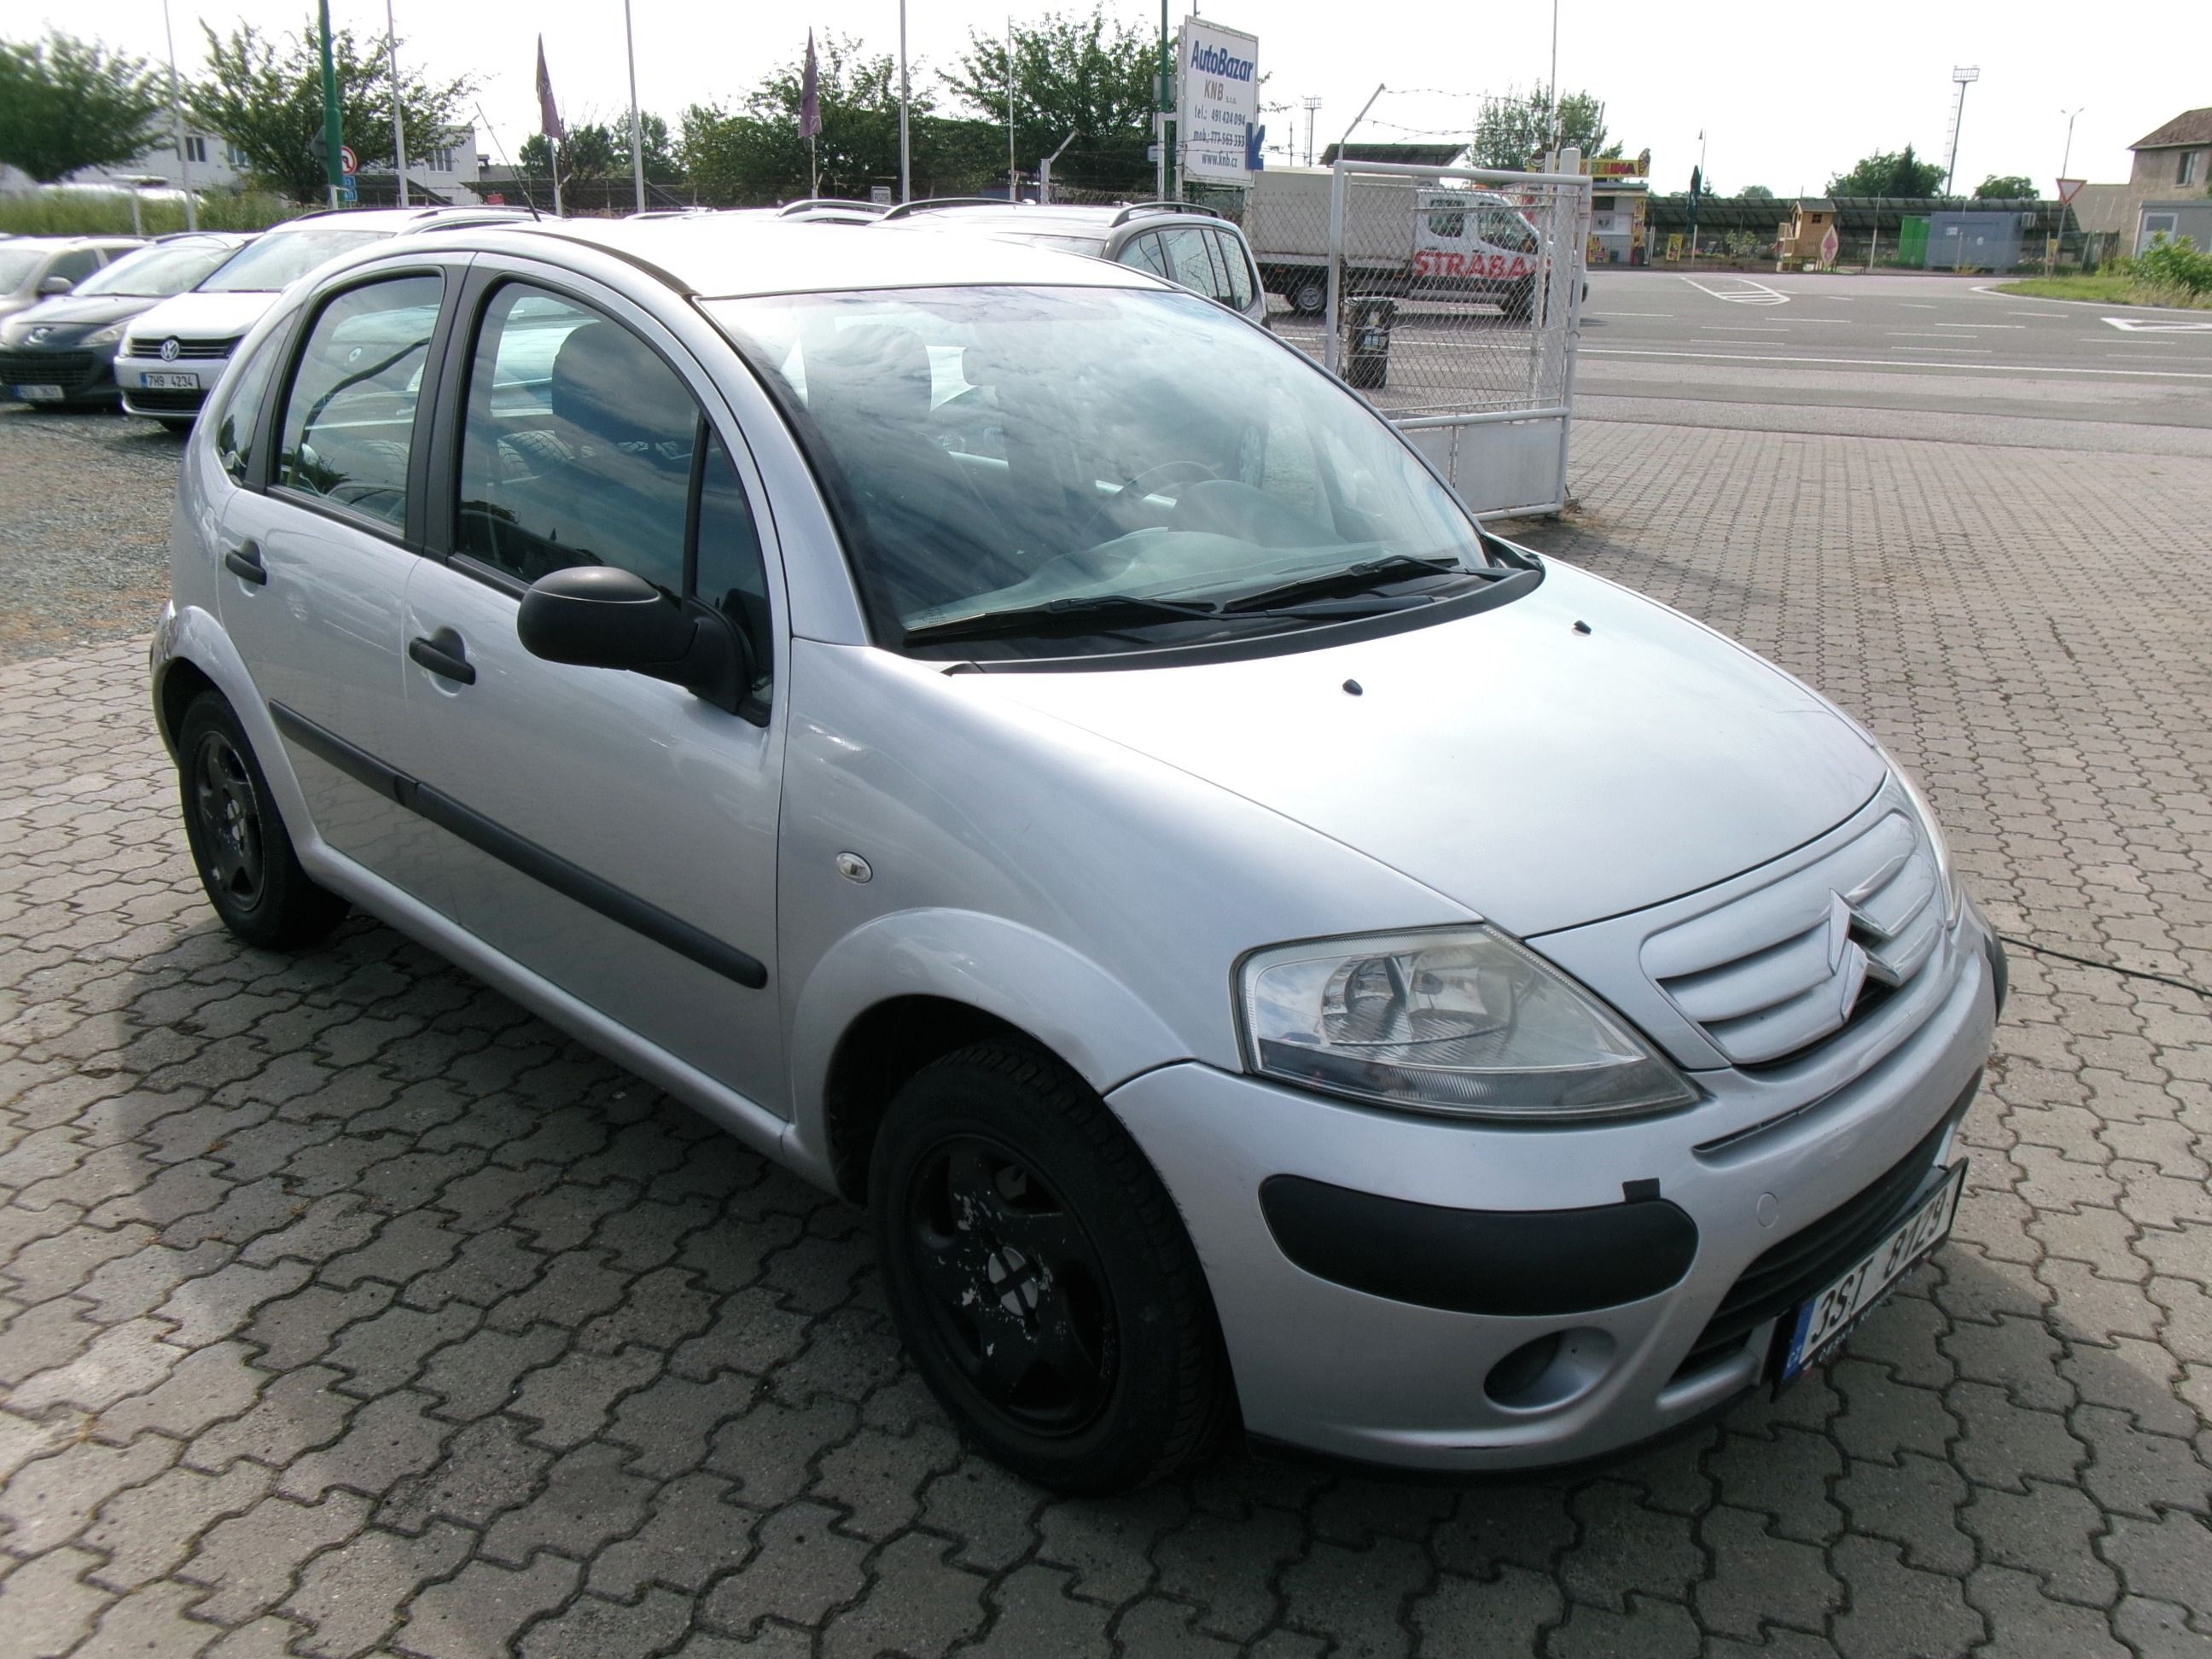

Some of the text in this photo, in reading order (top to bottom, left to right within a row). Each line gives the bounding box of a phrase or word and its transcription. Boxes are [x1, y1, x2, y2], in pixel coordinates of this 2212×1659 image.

[1190, 40, 1254, 82] AutoBazar
[1204, 79, 1224, 101] KNB
[1202, 152, 1237, 167] www.knb.cz
[1413, 250, 1538, 279] STRABA
[172, 375, 193, 387] 4234
[1811, 1256, 1875, 1344] 3ST
